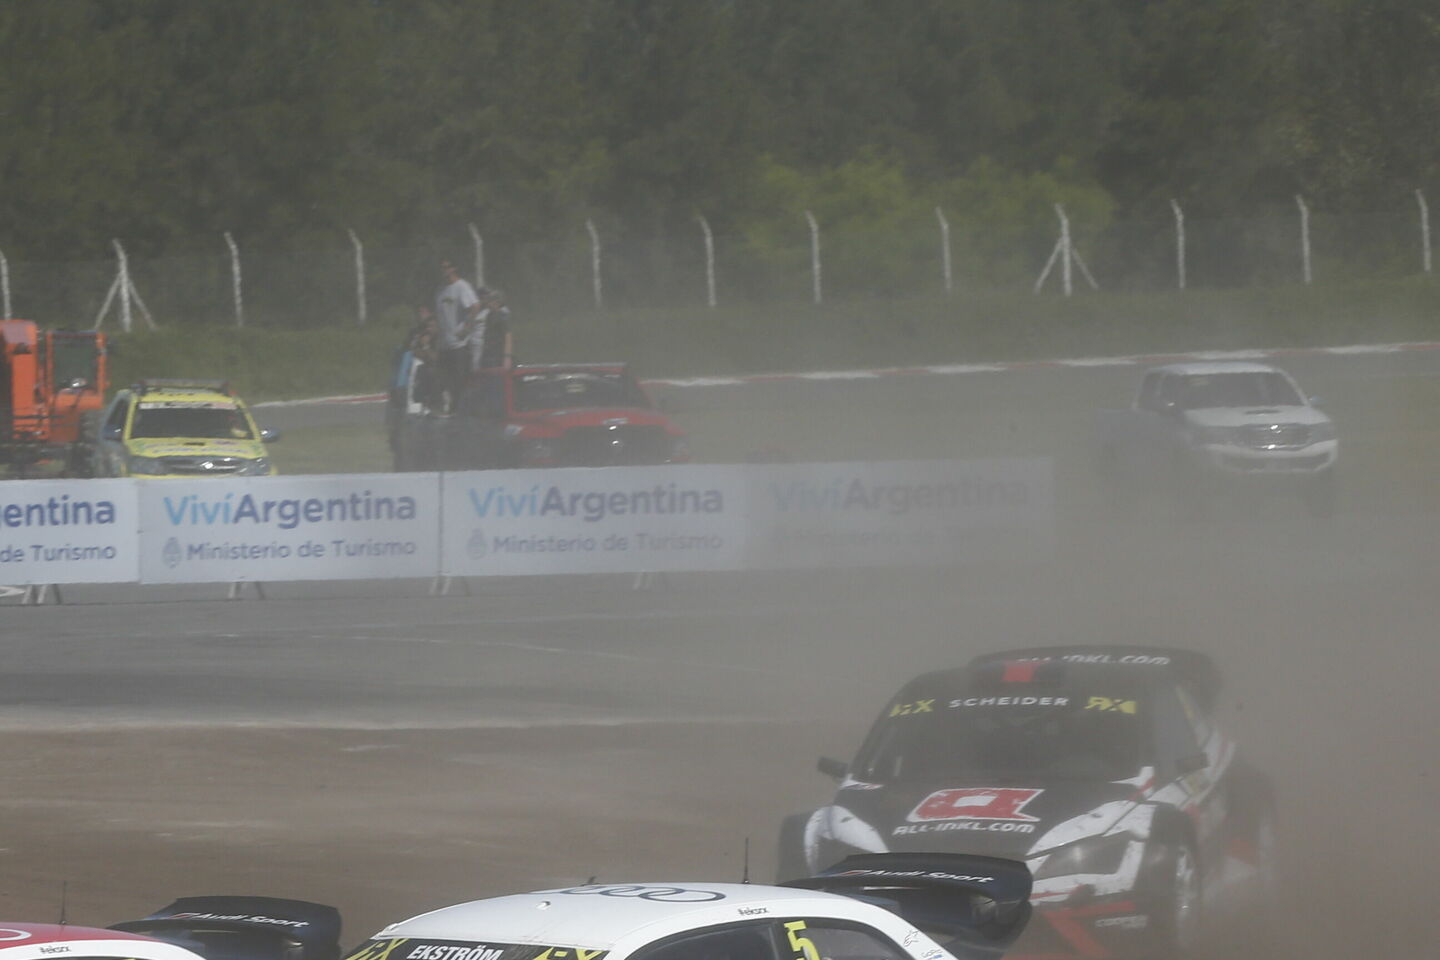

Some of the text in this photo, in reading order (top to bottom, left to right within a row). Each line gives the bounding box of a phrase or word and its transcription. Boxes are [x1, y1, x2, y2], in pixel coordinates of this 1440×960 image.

[187, 538, 416, 560] Ministerio de Turismo
[492, 531, 722, 553] Ministerio de Turismo
[30, 543, 116, 562] Turismo
[948, 696, 1069, 709] SCHEIDER
[923, 872, 994, 883] Sport
[245, 915, 310, 928] Sport
